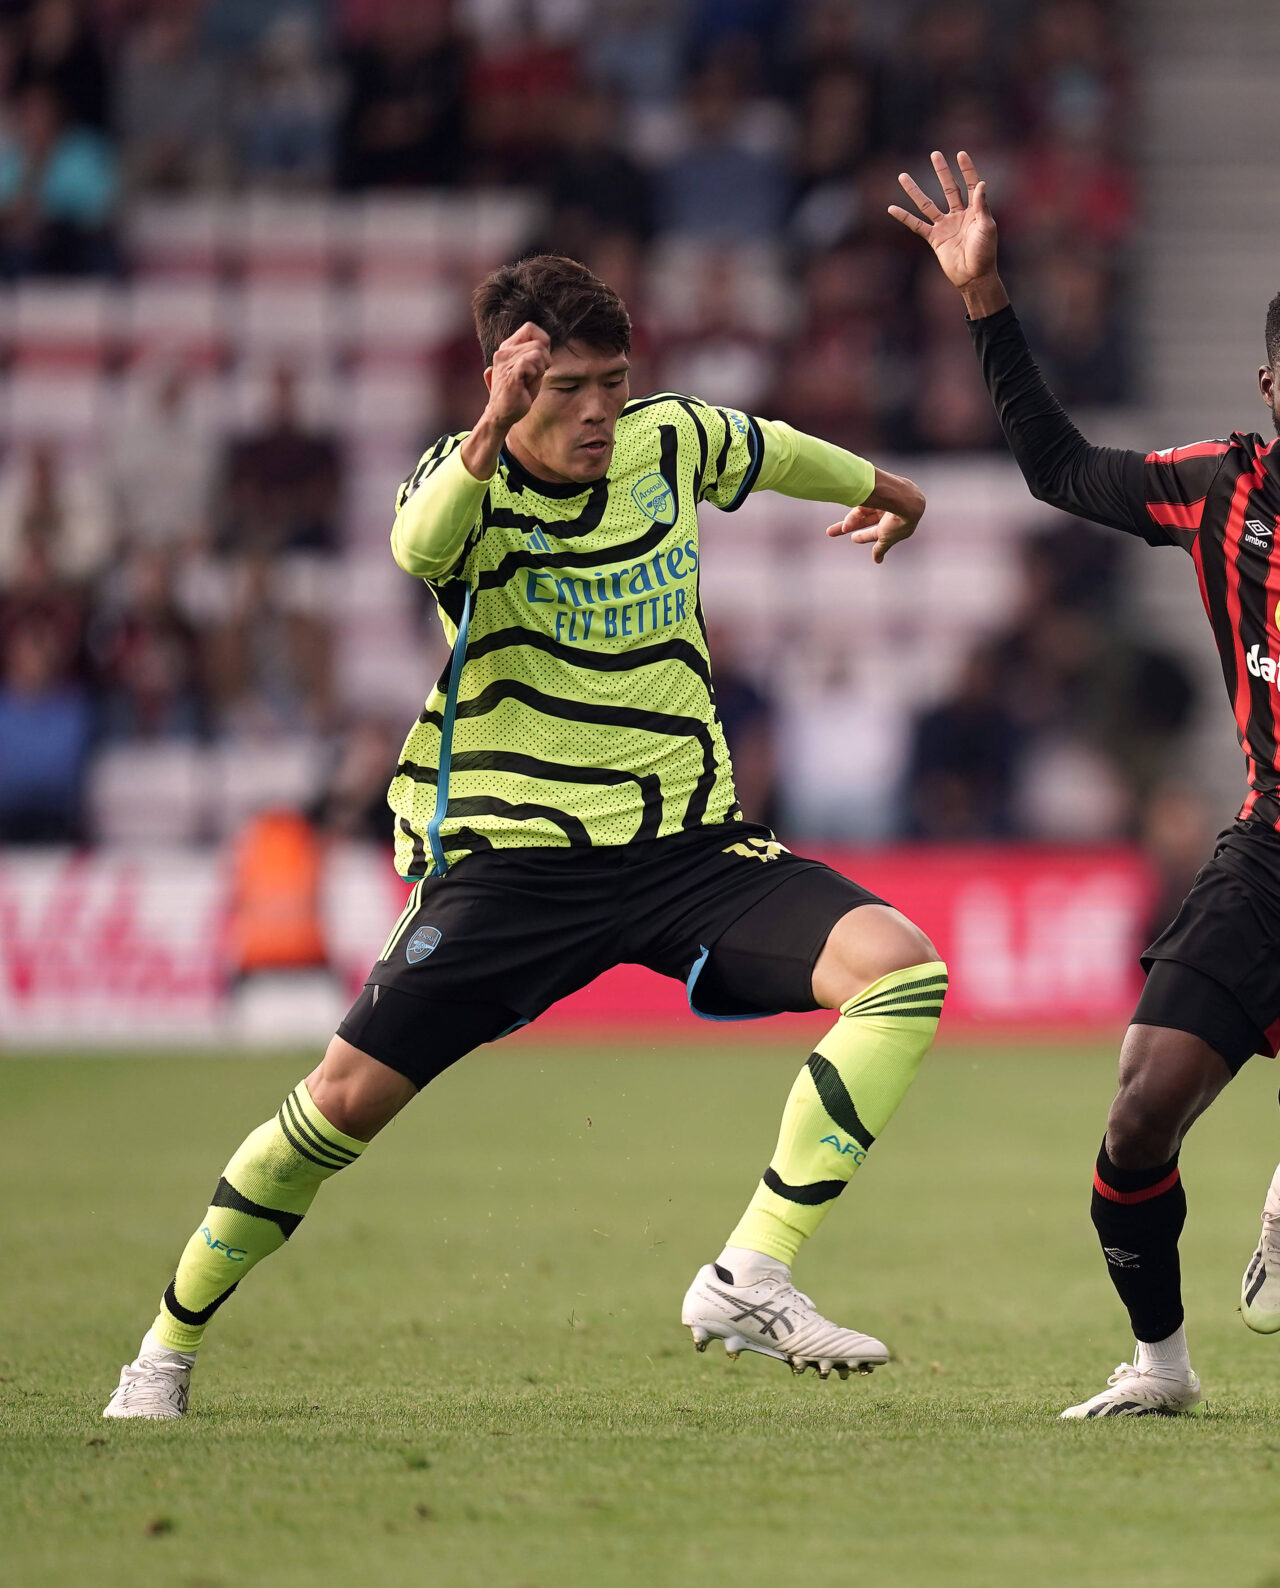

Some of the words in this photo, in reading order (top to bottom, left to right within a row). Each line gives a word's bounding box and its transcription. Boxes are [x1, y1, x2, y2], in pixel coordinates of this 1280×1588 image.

[639, 479, 664, 500] Arsenal
[1244, 533, 1269, 549] umbro
[526, 539, 699, 608] Emirates
[555, 610, 594, 642] FLY
[604, 588, 687, 639] BETTER
[820, 1135, 867, 1167] AFC
[201, 1227, 248, 1261] AFC
